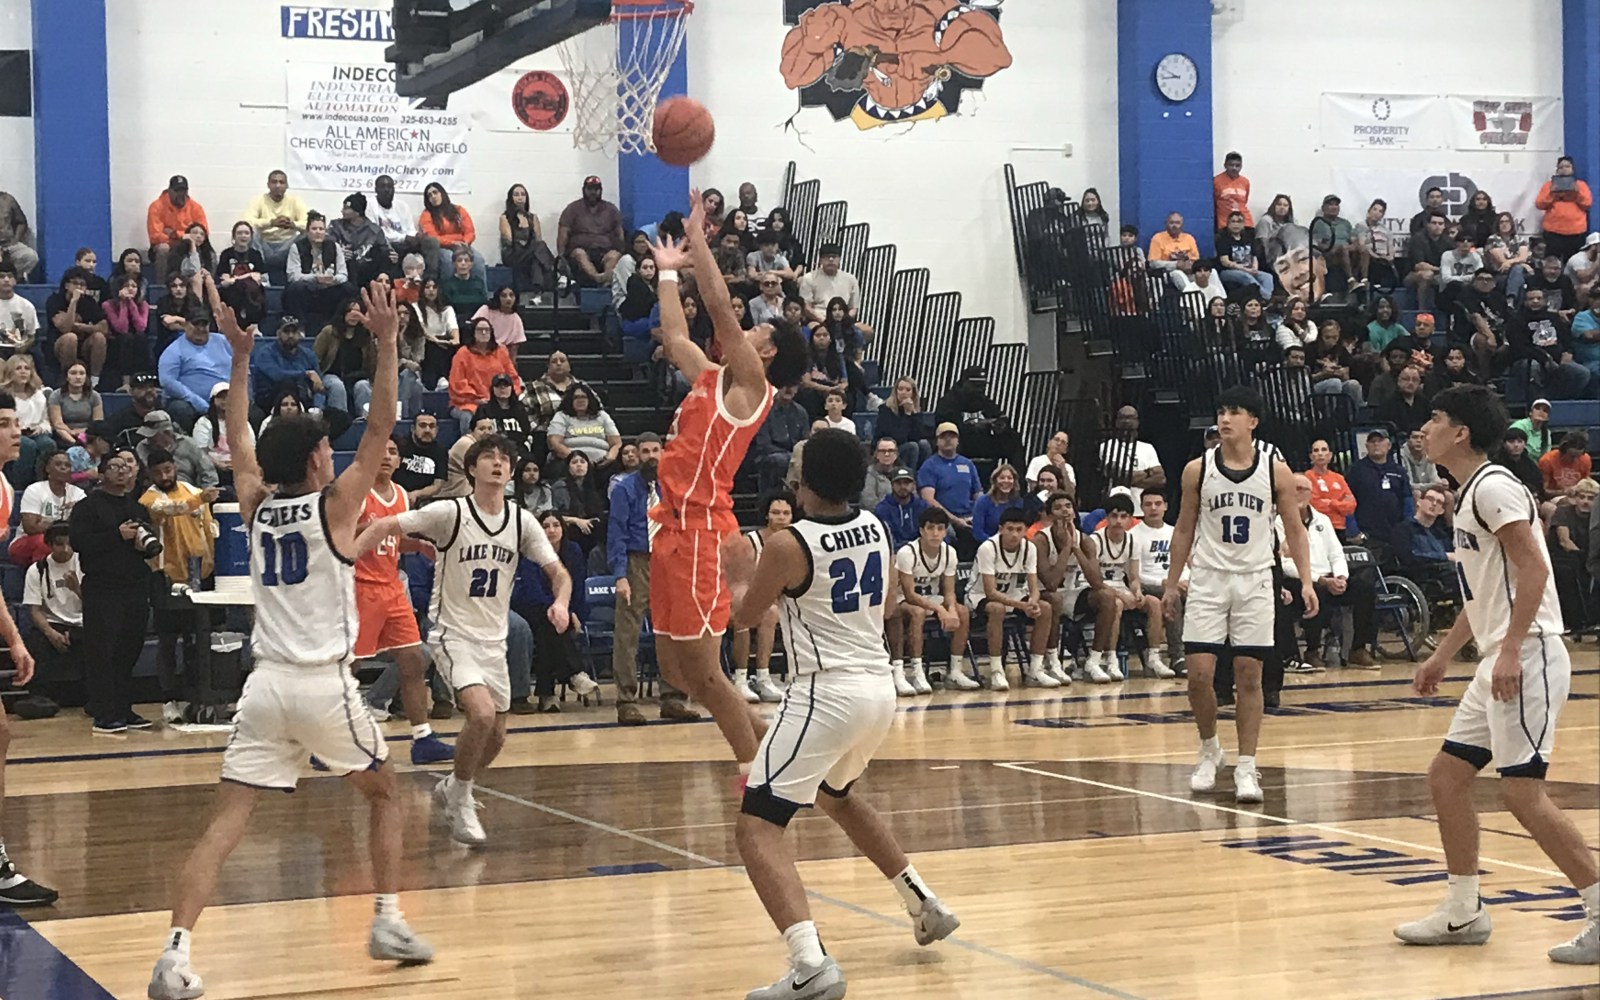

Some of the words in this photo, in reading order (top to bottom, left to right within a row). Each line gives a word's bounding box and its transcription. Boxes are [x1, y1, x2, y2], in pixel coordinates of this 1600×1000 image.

[310, 81, 397, 94] INDUSTRIA
[307, 92, 372, 104] ELECTRIC
[304, 102, 398, 114] AUTOMATION
[302, 112, 389, 124] www.indecousa.com
[325, 125, 351, 139] ALL
[1353, 125, 1409, 136] PROSPERITY
[290, 137, 365, 151] CHEVROLET
[370, 140, 383, 151] of
[386, 141, 413, 153] SAN
[417, 143, 467, 155] ANGELO
[1369, 136, 1394, 145] BANK
[305, 162, 455, 177] www.SanAngeloChevy.com
[1208, 492, 1234, 513] LAKE
[1237, 492, 1264, 514] VIEW
[1221, 515, 1250, 544] 13
[820, 523, 881, 553] CHIEFS
[261, 531, 310, 587] 10
[459, 544, 489, 563] LAKE
[491, 544, 515, 564] VIEW
[469, 568, 500, 598] 21
[829, 550, 883, 614] 24
[588, 586, 609, 595] LAKE
